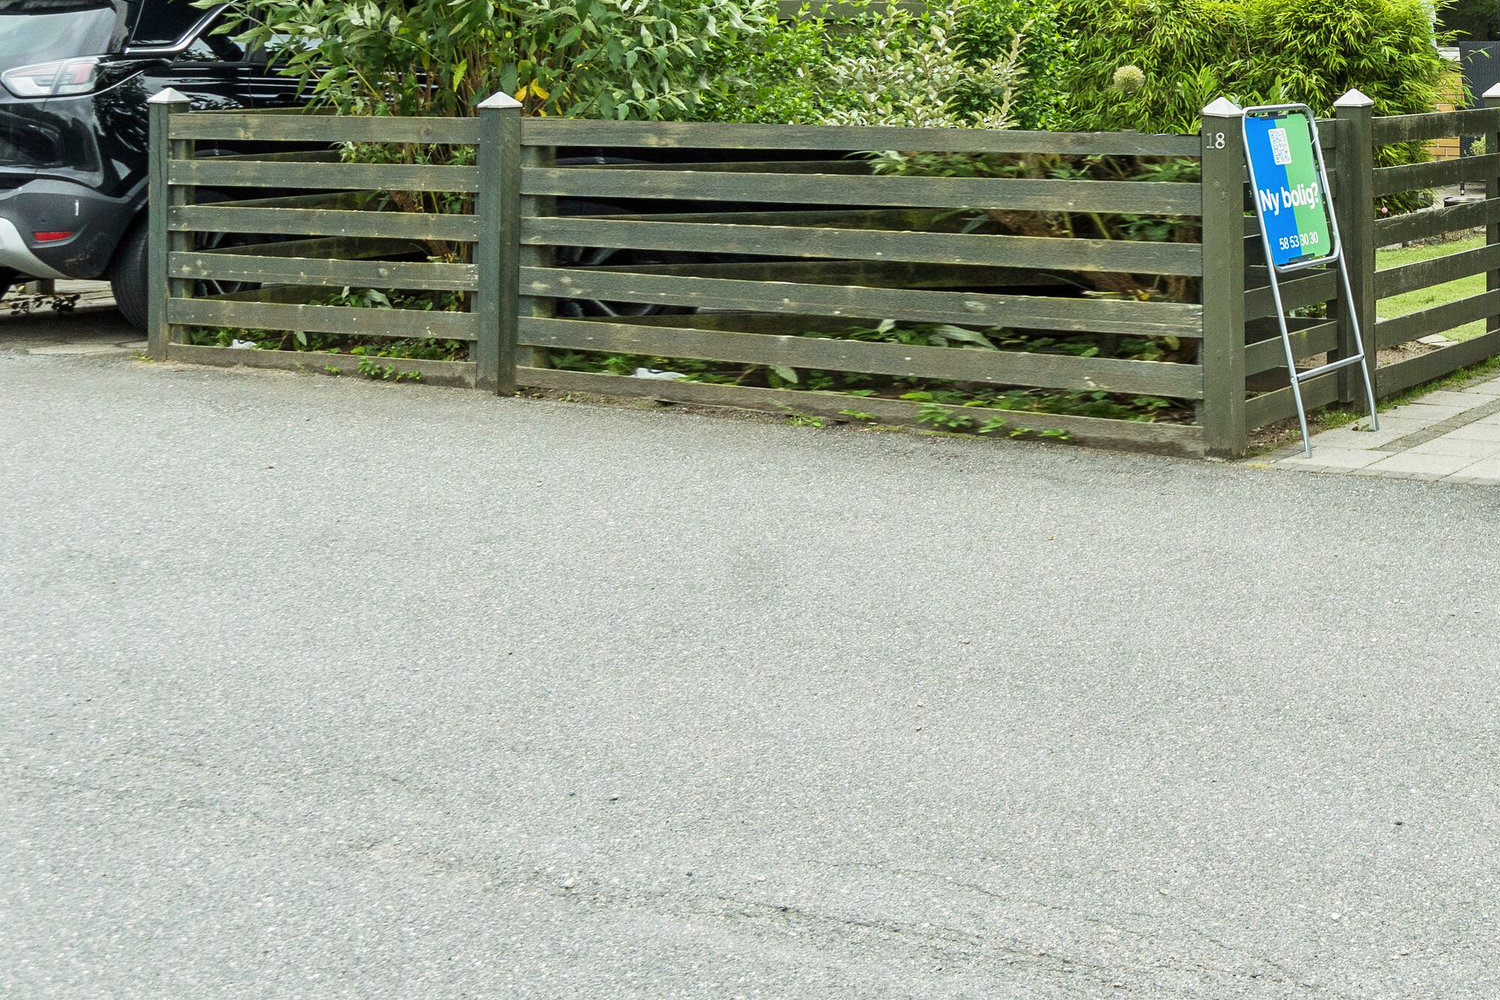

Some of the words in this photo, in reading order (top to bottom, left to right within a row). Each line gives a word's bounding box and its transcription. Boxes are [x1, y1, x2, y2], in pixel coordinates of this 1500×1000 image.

[1206, 132, 1225, 149] 18
[1260, 188, 1279, 216] Ny
[1281, 182, 1318, 209] bolig?
[1279, 236, 1290, 251] 58
[1289, 235, 1300, 249] 53
[1300, 233, 1309, 246] 30
[1309, 231, 1319, 244] 30
